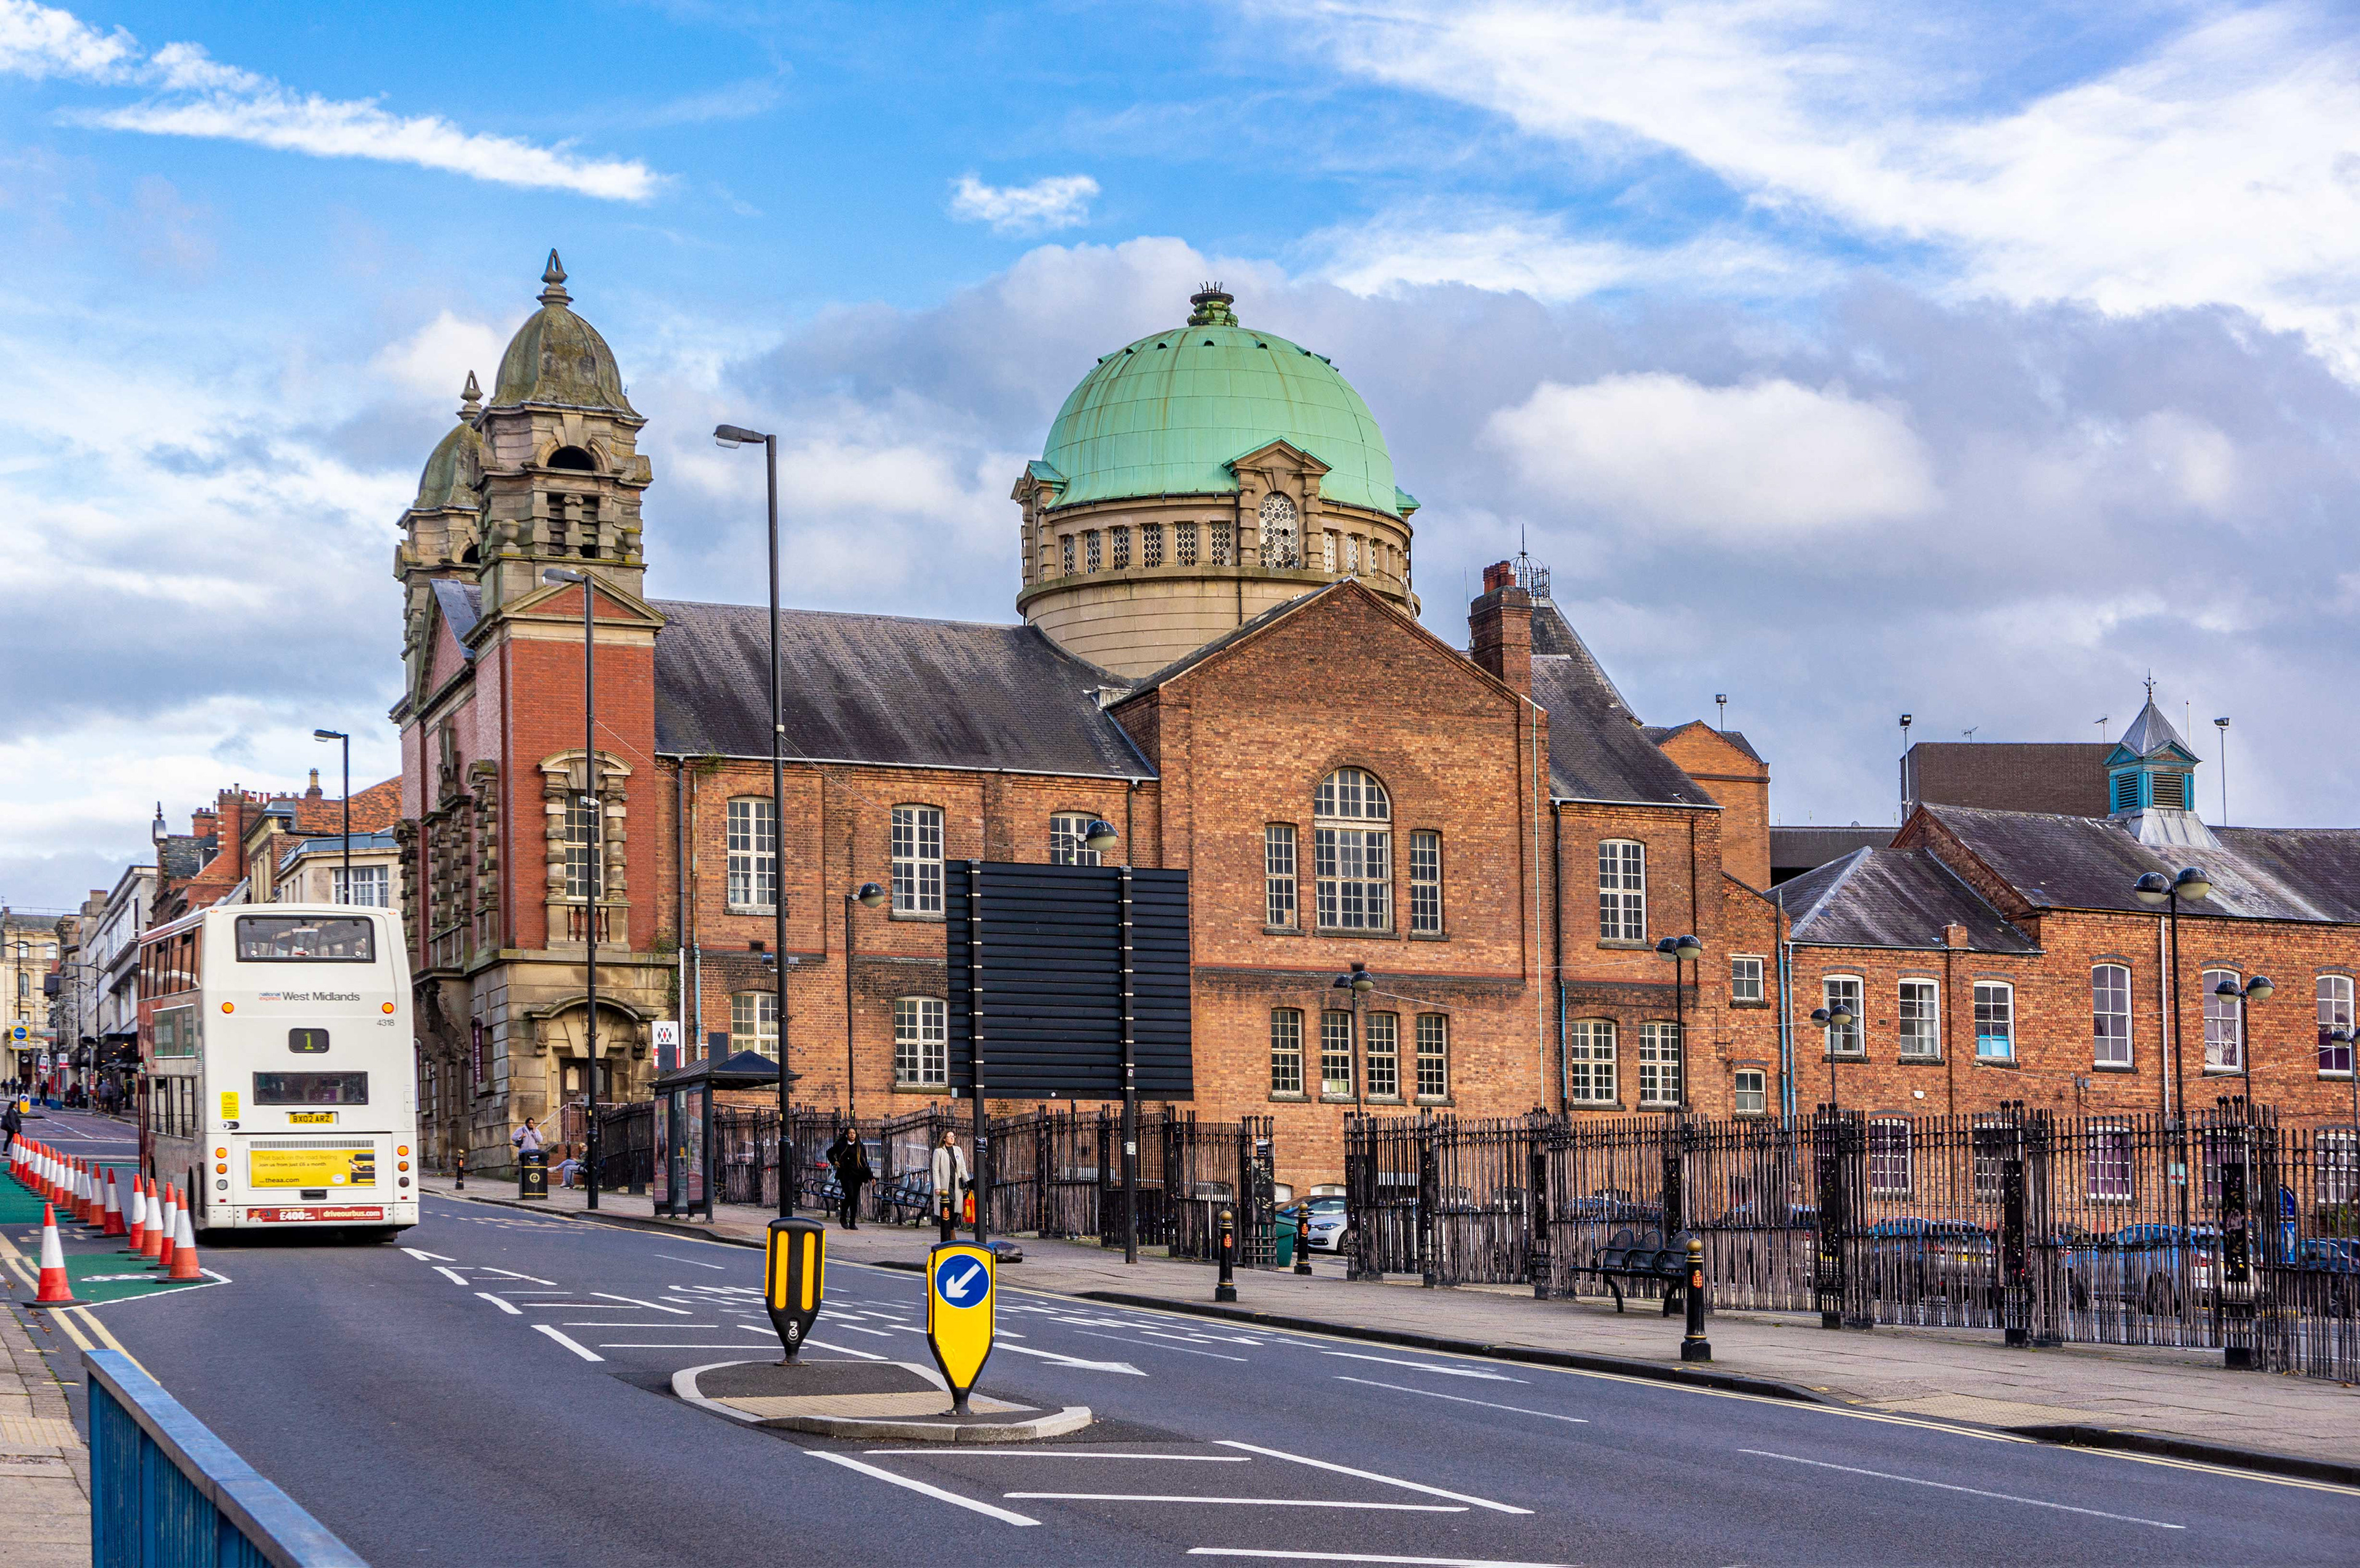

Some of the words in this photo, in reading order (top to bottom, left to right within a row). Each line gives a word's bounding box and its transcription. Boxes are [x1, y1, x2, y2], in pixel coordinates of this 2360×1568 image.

[282, 992, 310, 1001] West
[312, 992, 360, 1001] Midlands
[304, 1032, 313, 1050] 1
[279, 1211, 305, 1220] £400
